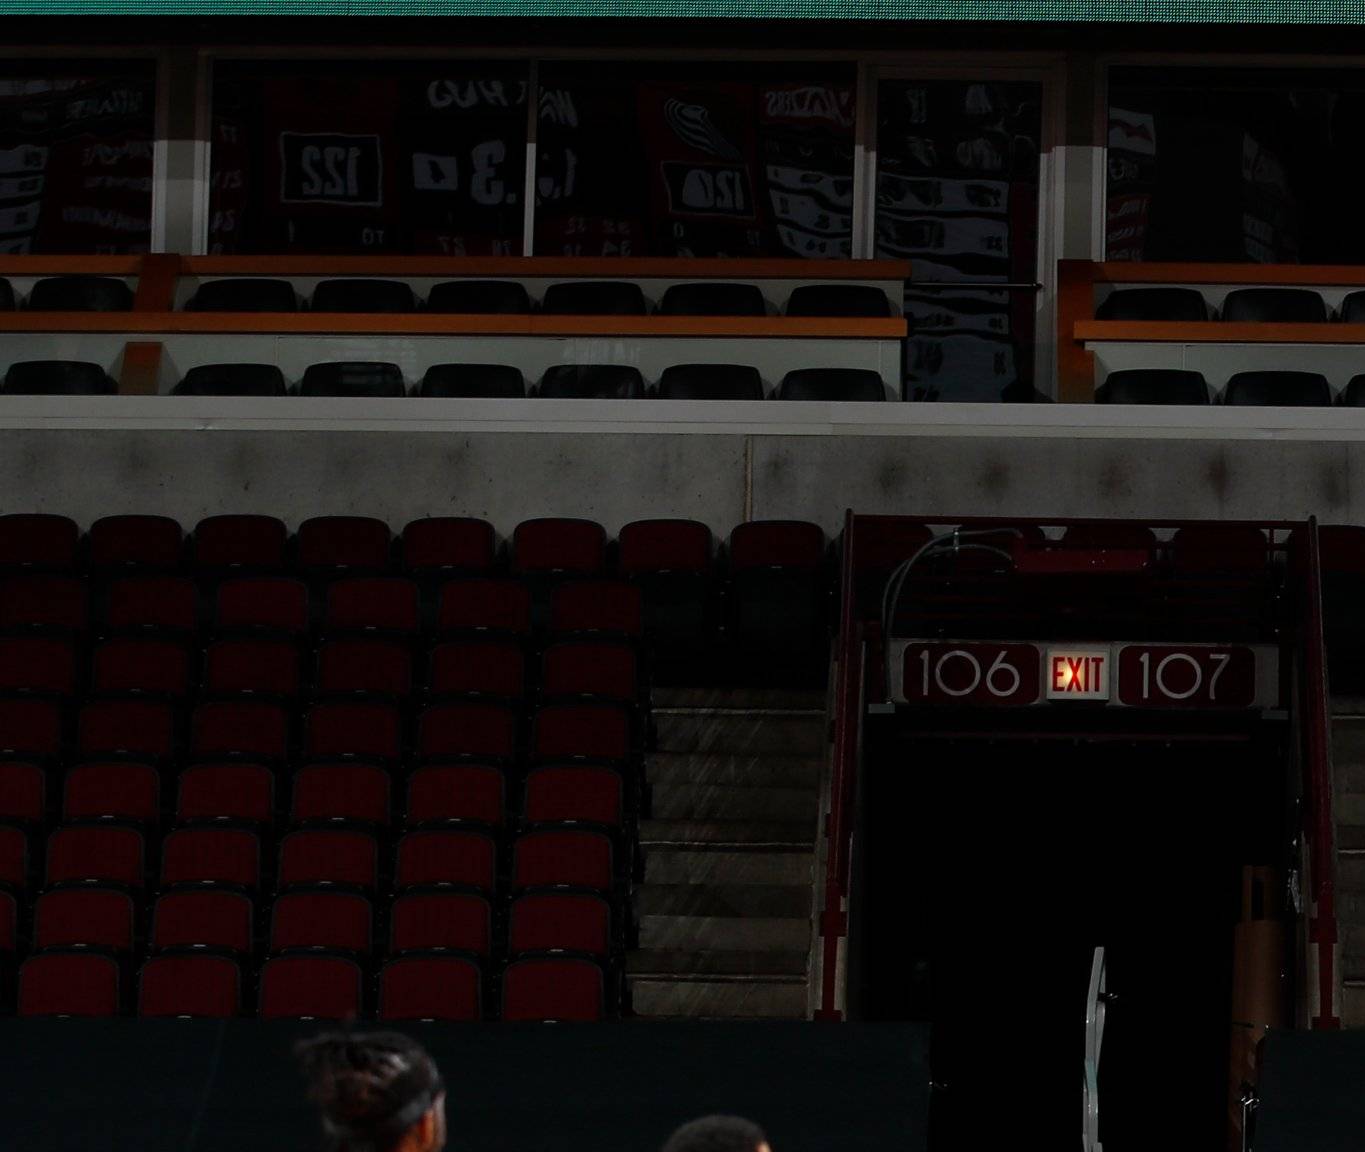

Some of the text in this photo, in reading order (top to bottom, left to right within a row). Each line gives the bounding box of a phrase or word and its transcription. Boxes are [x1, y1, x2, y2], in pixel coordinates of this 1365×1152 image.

[919, 650, 1020, 697] 106
[1052, 656, 1104, 692] EXIT
[1139, 652, 1231, 700] 107
